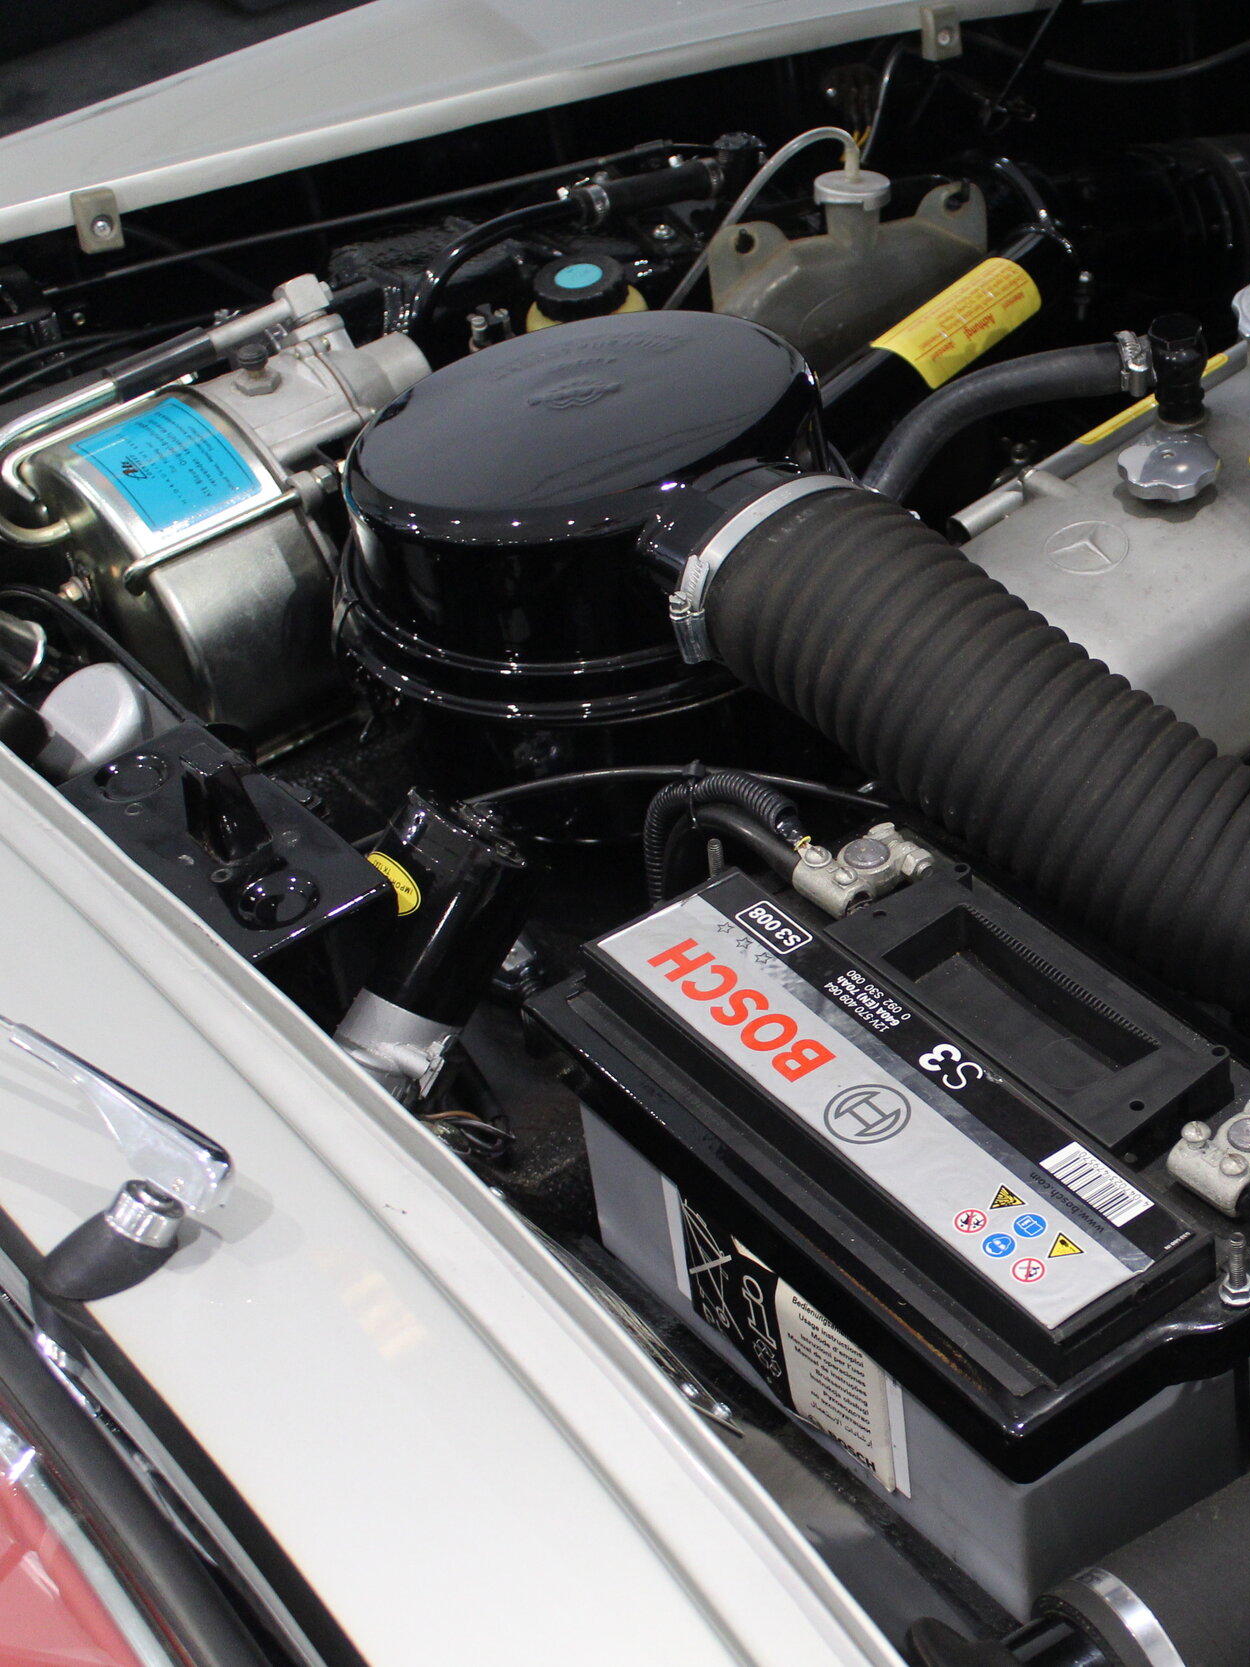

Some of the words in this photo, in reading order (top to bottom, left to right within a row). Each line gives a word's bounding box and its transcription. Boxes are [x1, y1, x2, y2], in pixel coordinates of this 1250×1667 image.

[749, 906, 776, 930] 008
[775, 926, 801, 948] S3
[837, 975, 860, 995] 70Ah
[846, 970, 866, 984] 080
[824, 982, 843, 996] 064
[864, 984, 884, 999] S30
[648, 938, 837, 1082] BOSCH
[839, 994, 858, 1007] 409
[856, 992, 880, 1010] (EN)
[882, 998, 902, 1013] 092
[855, 1006, 874, 1021] 570
[876, 1007, 900, 1026] 640A
[869, 1018, 889, 1032] 12V
[919, 1043, 983, 1090] S3
[1028, 1171, 1106, 1234] www.bosch.com
[798, 1313, 820, 1332] Usage
[821, 1329, 863, 1358] instructions
[811, 1331, 830, 1349] Mode
[794, 1345, 819, 1367] Manual
[821, 1364, 829, 1373] de
[800, 1333, 832, 1358] Istruzioni
[834, 1356, 845, 1366] per
[787, 1332, 812, 1353] Manual
[813, 1351, 821, 1360] de
[823, 1358, 866, 1387] operaciones
